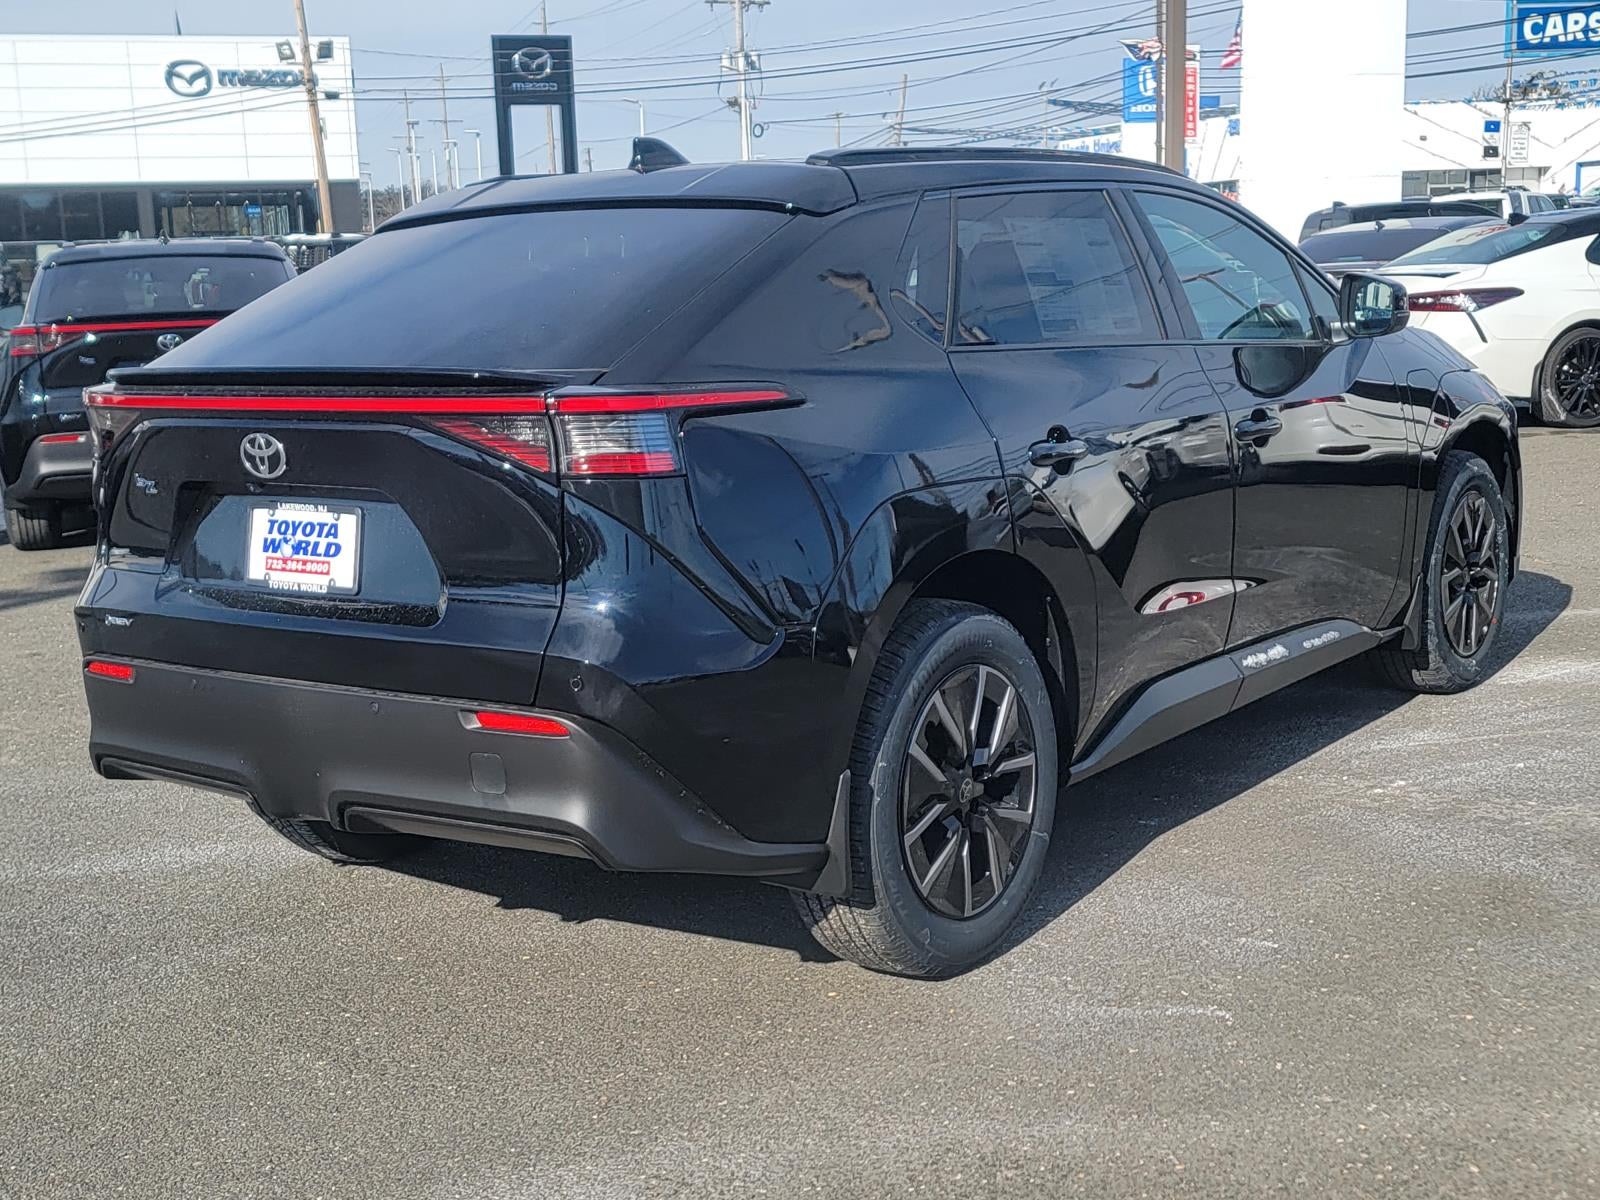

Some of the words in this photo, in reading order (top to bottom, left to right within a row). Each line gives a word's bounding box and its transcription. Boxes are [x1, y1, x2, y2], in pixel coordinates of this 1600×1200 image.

[1523, 12, 1600, 44] CARS
[512, 82, 558, 91] mazda
[1185, 67, 1196, 136] CERTIFIED
[318, 504, 328, 512] NJ
[267, 519, 339, 539] TOYOTA
[266, 558, 329, 574] 732-364-9000
[268, 580, 299, 591] TOYOTA
[300, 583, 328, 593] WORLD
